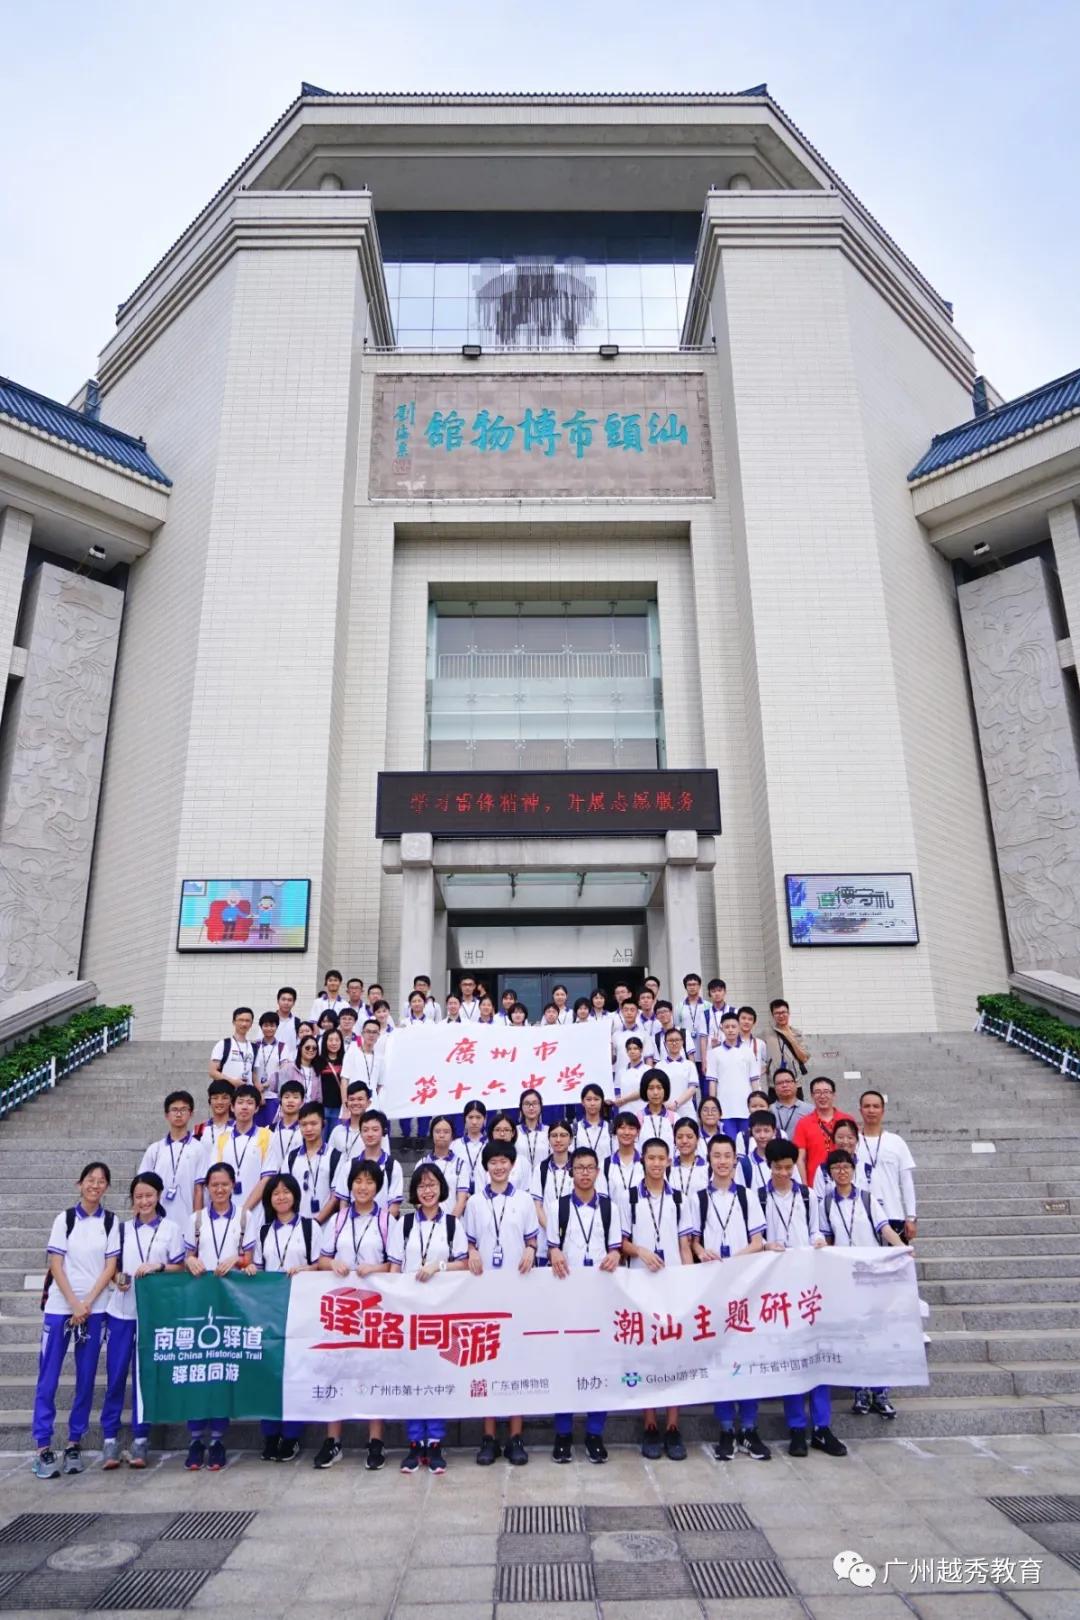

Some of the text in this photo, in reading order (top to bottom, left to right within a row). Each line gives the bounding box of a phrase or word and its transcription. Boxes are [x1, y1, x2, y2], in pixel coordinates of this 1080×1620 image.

[464, 949, 483, 959] 出口
[614, 948, 633, 957] 入口
[309, 1287, 513, 1368] 驿路同游
[153, 1350, 263, 1361] South China Historical Trail
[172, 1362, 240, 1384] 驿路同游
[370, 1384, 455, 1396] 广州市第十六中学
[491, 1379, 549, 1391] 广东省博物馆
